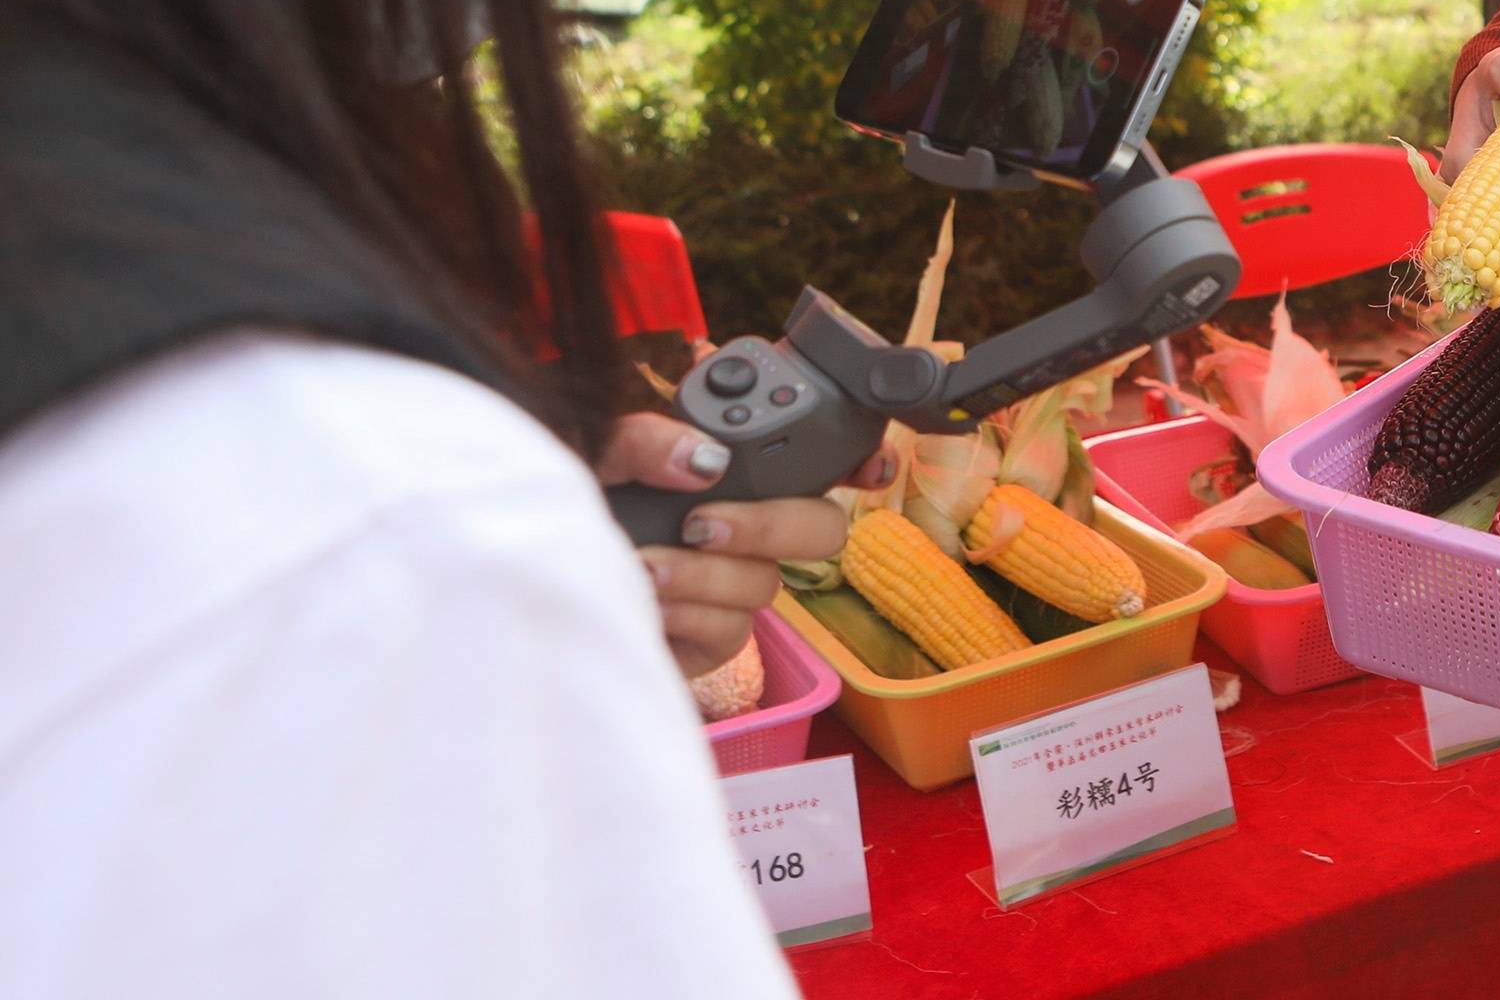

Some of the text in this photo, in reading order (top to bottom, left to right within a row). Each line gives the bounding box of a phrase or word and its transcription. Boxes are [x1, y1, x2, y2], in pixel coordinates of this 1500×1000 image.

[1056, 761, 1159, 819] 彩糯4号
[750, 852, 804, 885] 168
